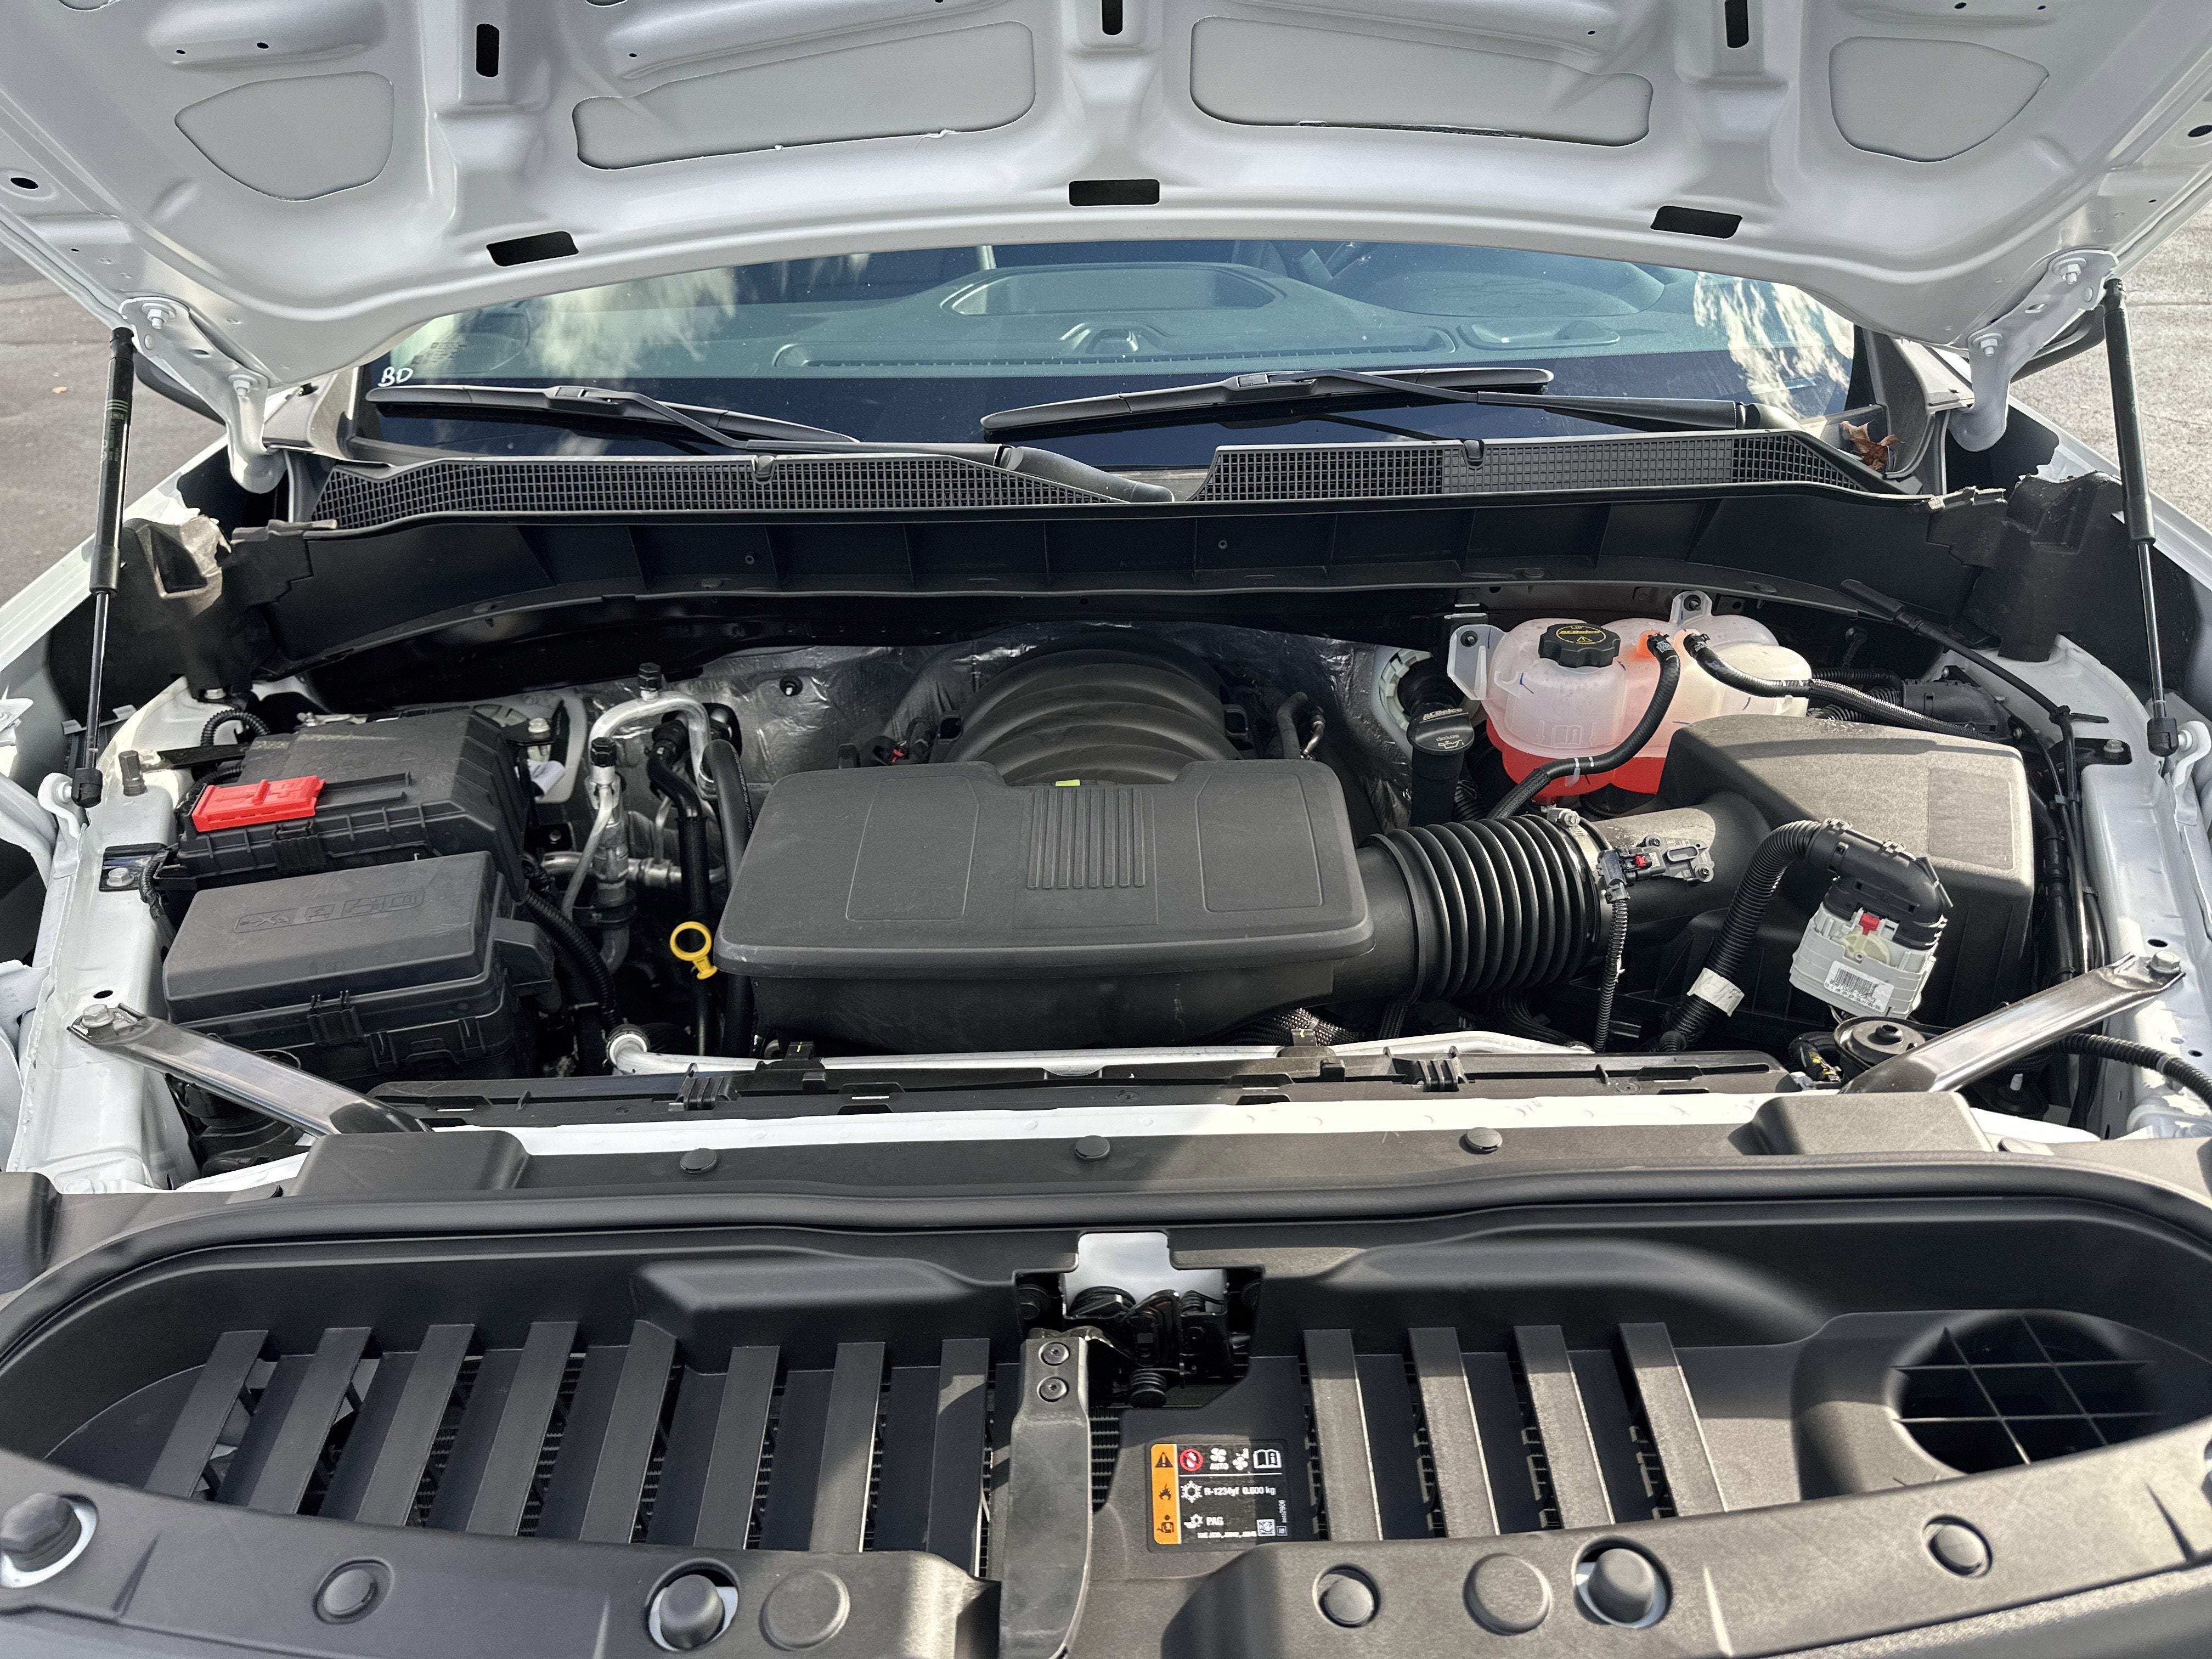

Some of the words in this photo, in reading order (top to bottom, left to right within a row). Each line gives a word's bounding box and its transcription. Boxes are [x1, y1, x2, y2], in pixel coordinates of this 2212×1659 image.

[377, 366, 413, 387] BD
[1423, 708, 1463, 721] ACDelco
[1204, 1487, 1239, 1497] R-1234yf
[1242, 1486, 1265, 1495] 0.600
[1265, 1486, 1277, 1496] kg
[1206, 1516, 1224, 1526] PAG
